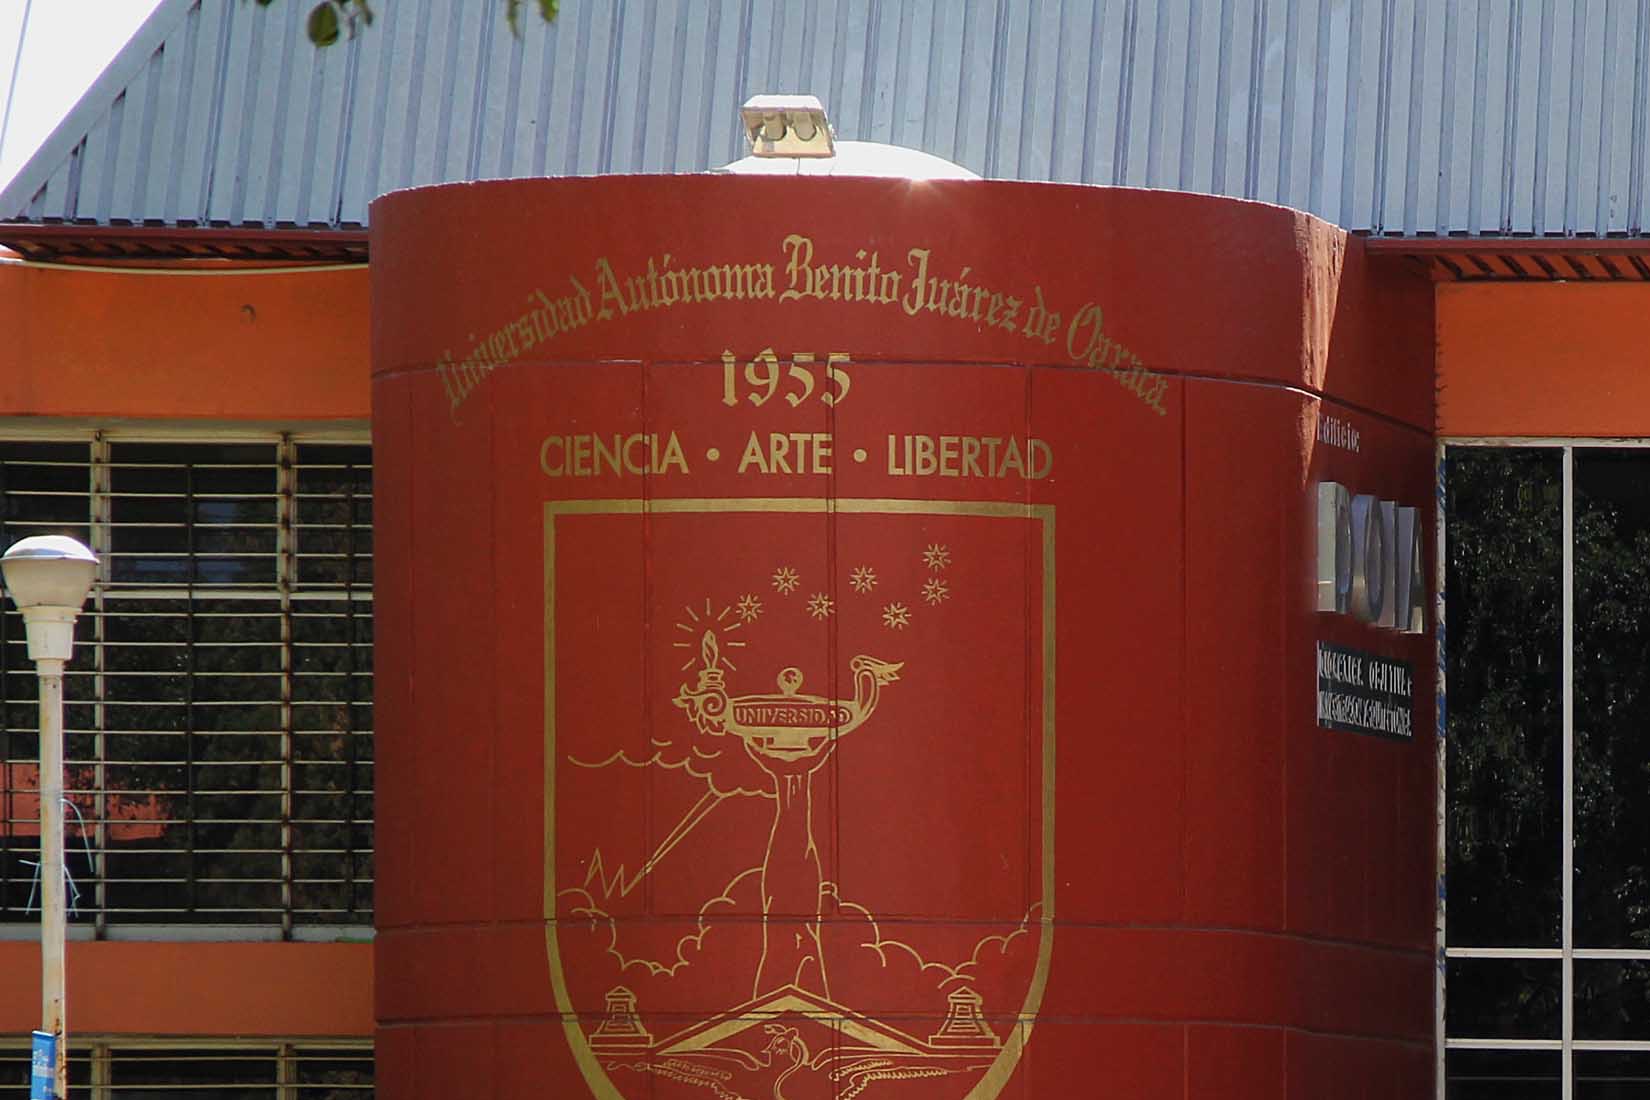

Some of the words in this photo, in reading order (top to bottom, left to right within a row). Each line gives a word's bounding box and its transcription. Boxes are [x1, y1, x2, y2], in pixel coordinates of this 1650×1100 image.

[595, 254, 776, 321] Autónoma
[779, 233, 902, 304] Benito
[902, 247, 1024, 333] Juárez
[1022, 286, 1062, 344] de
[721, 347, 851, 408] 1955
[539, 431, 690, 478] CIENCIA
[737, 431, 834, 477] ARTE
[887, 432, 1054, 480] LIBERTAD
